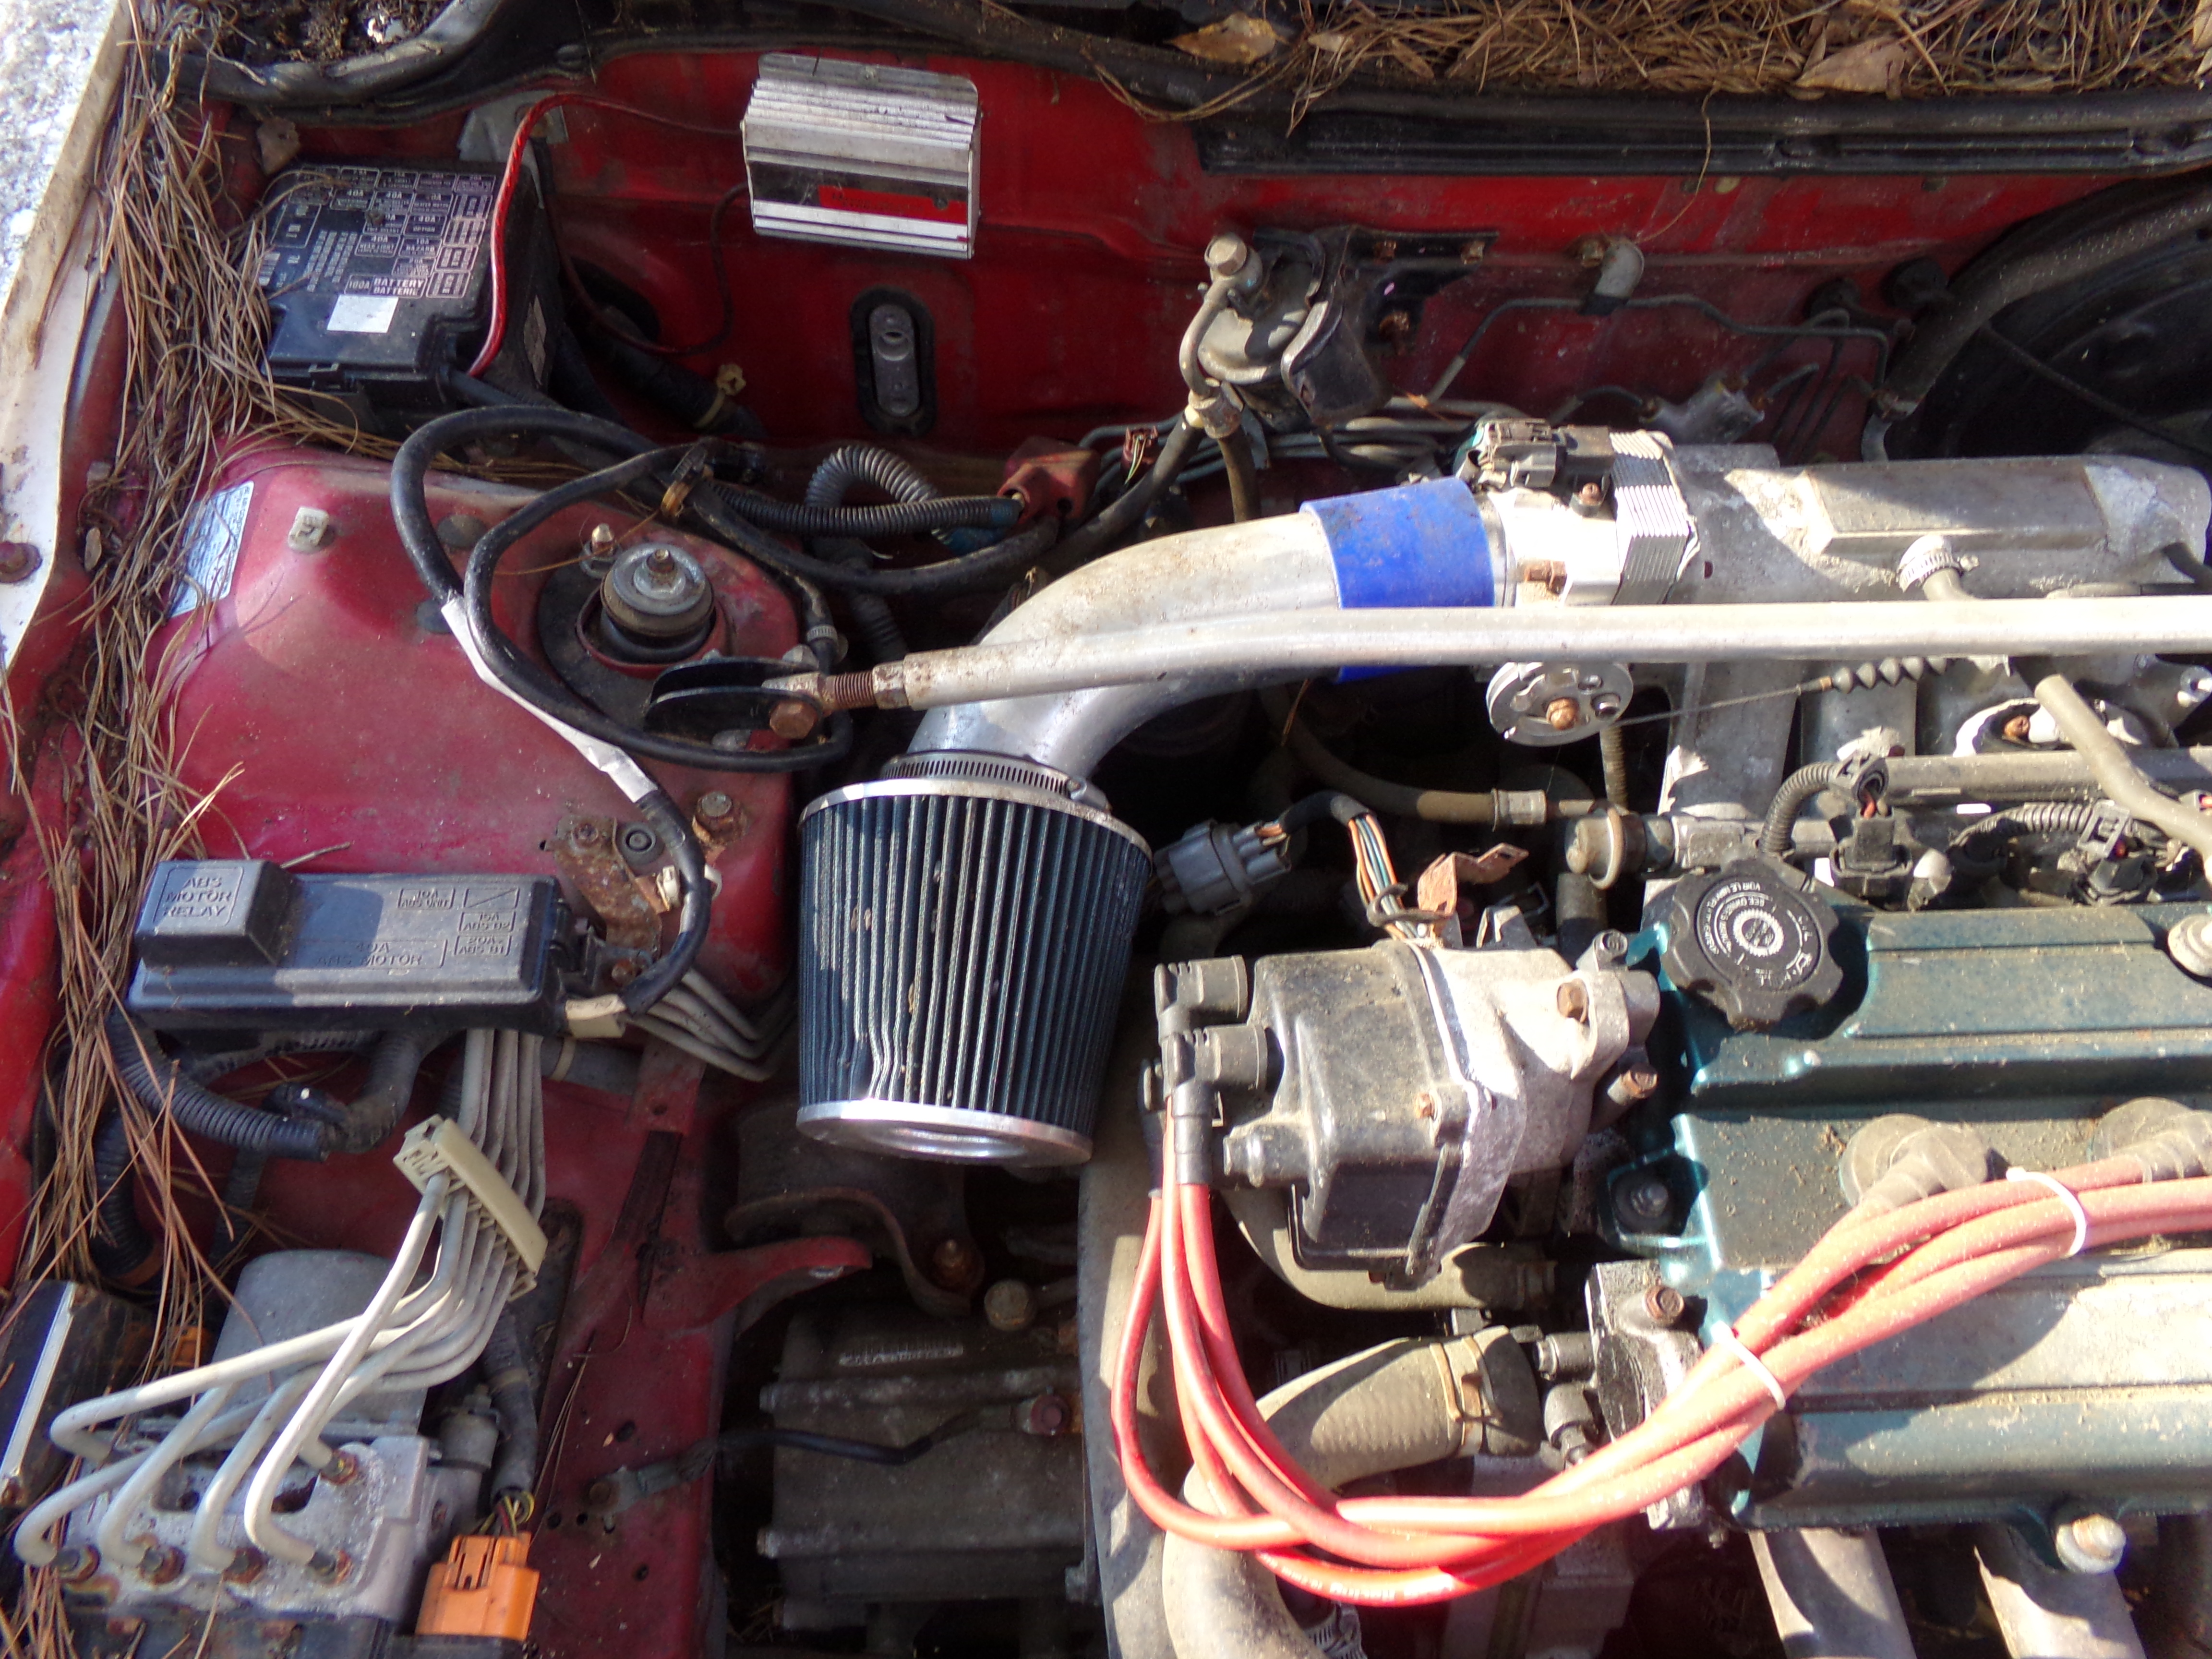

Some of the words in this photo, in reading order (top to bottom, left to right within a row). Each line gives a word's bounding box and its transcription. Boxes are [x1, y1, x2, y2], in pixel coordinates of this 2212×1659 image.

[349, 280, 370, 289] 100A
[374, 277, 424, 288] BATTERY
[373, 287, 419, 296] BATTERIE
[182, 877, 223, 888] ABS
[166, 890, 231, 902] MOTOR
[163, 906, 226, 917] RELAY
[360, 954, 423, 966] MOTOR
